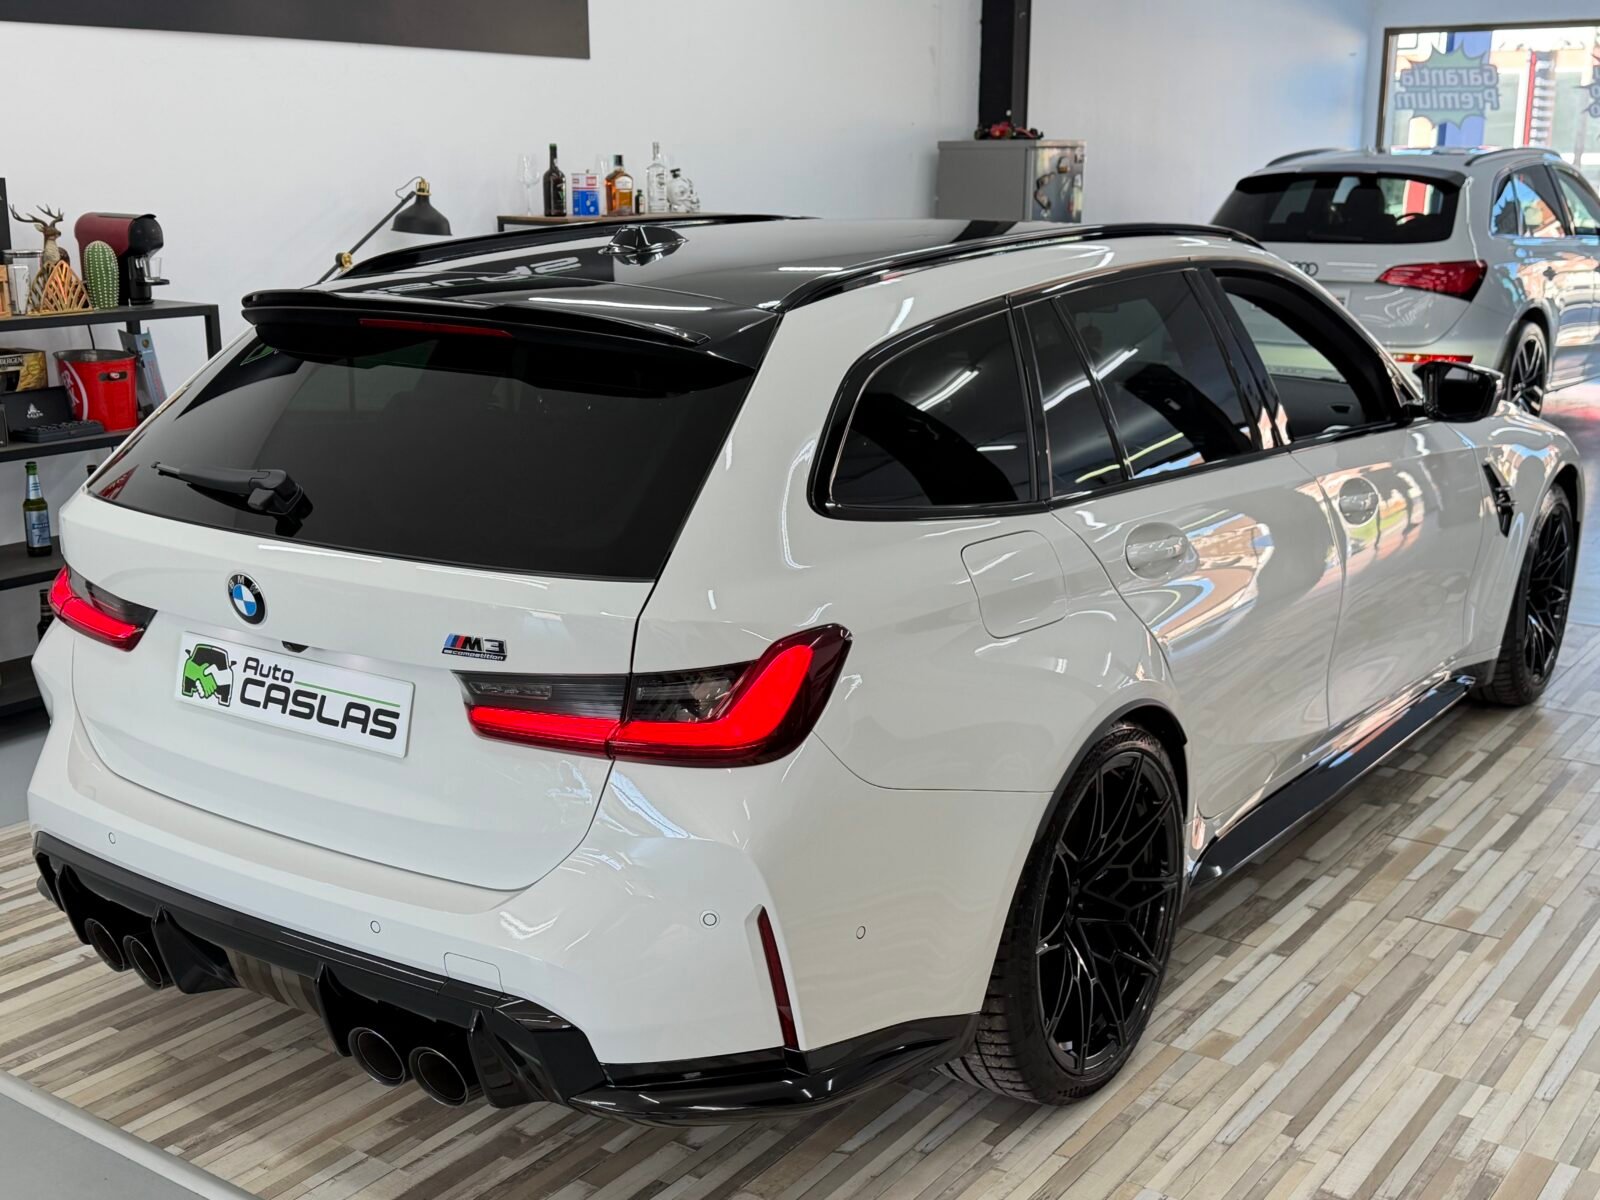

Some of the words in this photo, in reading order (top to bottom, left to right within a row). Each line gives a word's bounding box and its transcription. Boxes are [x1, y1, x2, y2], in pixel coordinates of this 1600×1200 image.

[229, 575, 260, 595] BMW
[461, 635, 507, 654] M3
[243, 656, 294, 684] Auto
[239, 677, 400, 740] CASLAS
